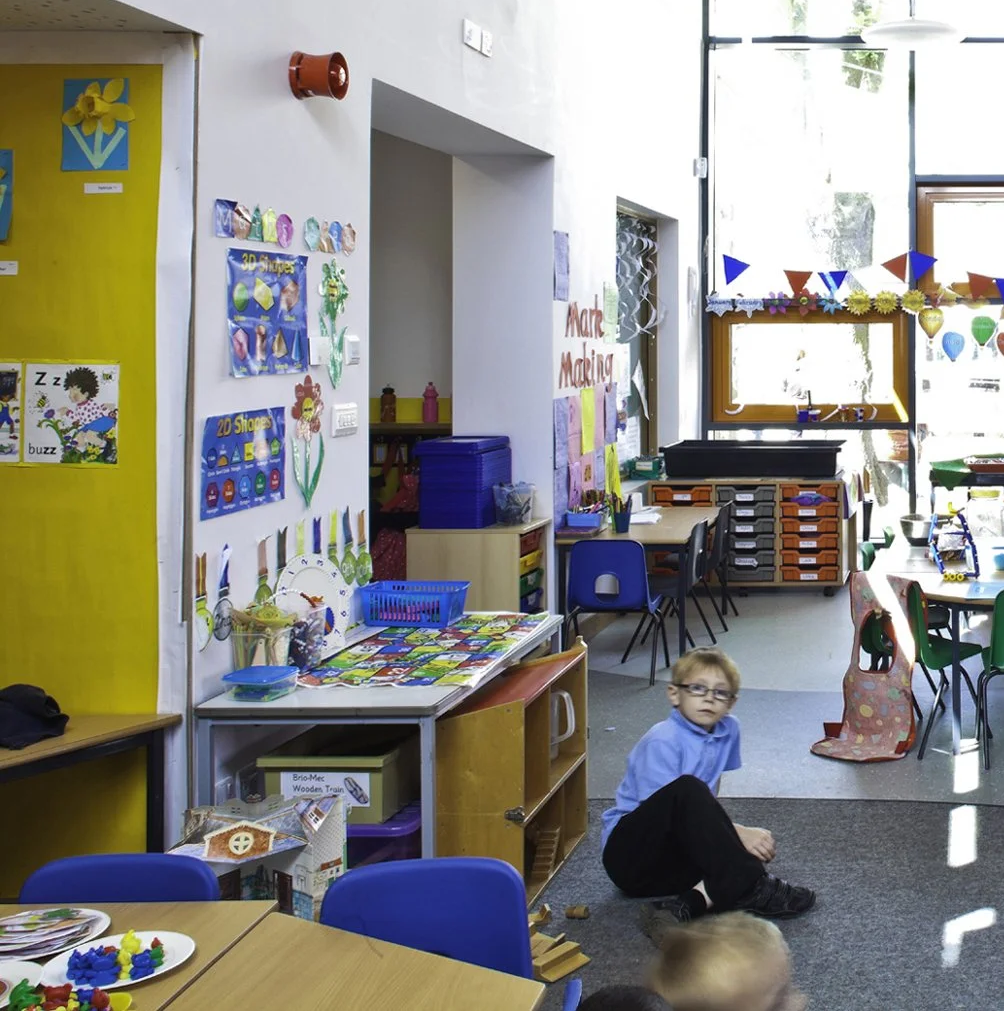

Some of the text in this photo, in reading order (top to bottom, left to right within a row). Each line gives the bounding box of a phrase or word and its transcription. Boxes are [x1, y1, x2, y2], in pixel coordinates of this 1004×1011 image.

[240, 253, 296, 277] 3D Shapes
[565, 294, 605, 339] Mark
[559, 342, 613, 393] Making
[34, 371, 62, 386] Z z
[216, 413, 273, 439] 2D Shapes
[28, 442, 57, 456] buzz
[340, 610, 347, 618] 6
[292, 773, 325, 782] Brio-Mec
[292, 784, 345, 793] Wooden Train
